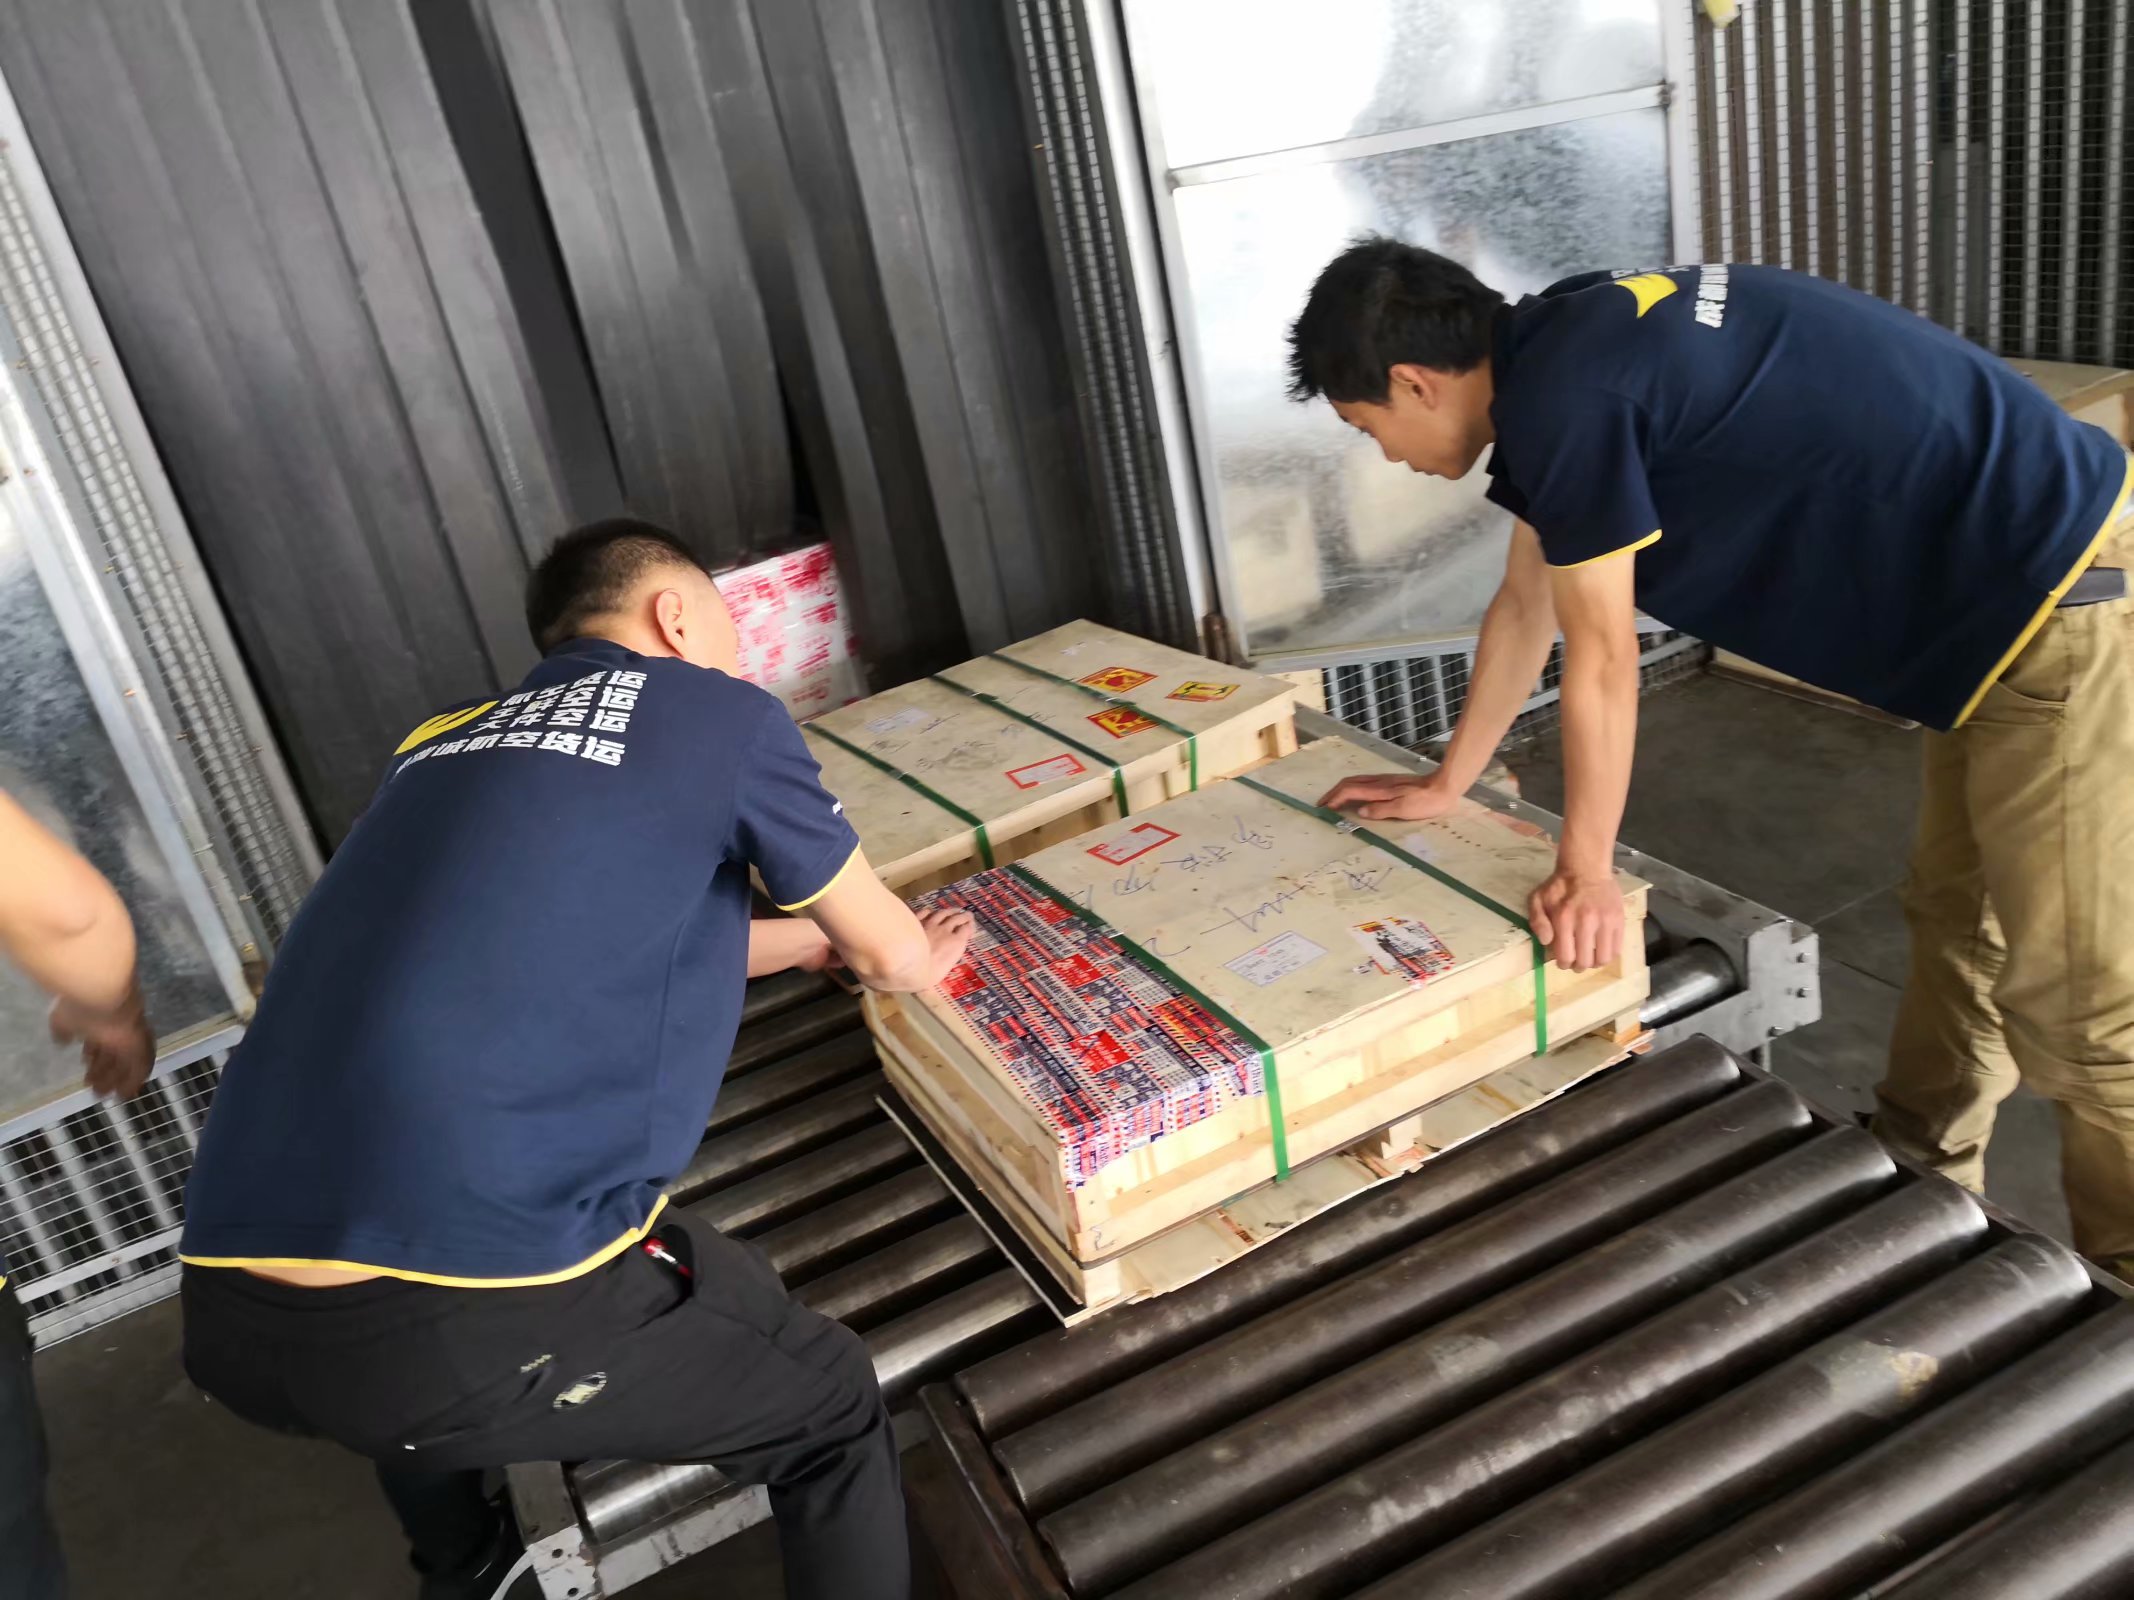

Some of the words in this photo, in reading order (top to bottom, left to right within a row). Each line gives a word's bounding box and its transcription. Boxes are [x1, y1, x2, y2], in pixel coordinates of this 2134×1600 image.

[501, 670, 648, 708] 航空货运
[468, 709, 631, 734] 大件空运
